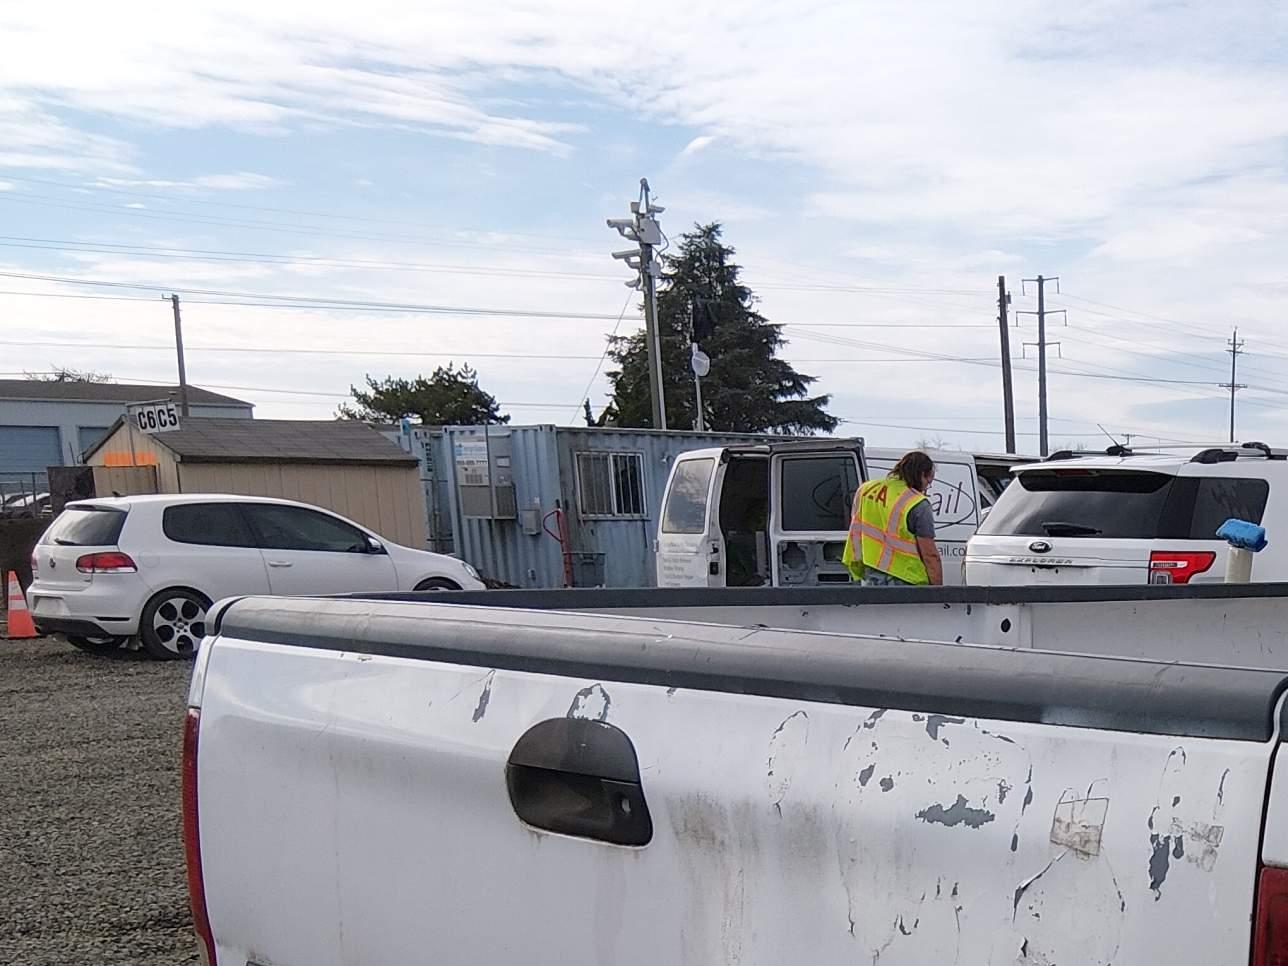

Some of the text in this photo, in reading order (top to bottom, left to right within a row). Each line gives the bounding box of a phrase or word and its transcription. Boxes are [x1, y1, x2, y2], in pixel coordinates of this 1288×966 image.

[138, 409, 178, 430] C6 C5
[931, 481, 963, 516] ail
[938, 544, 967, 558] ail.co
